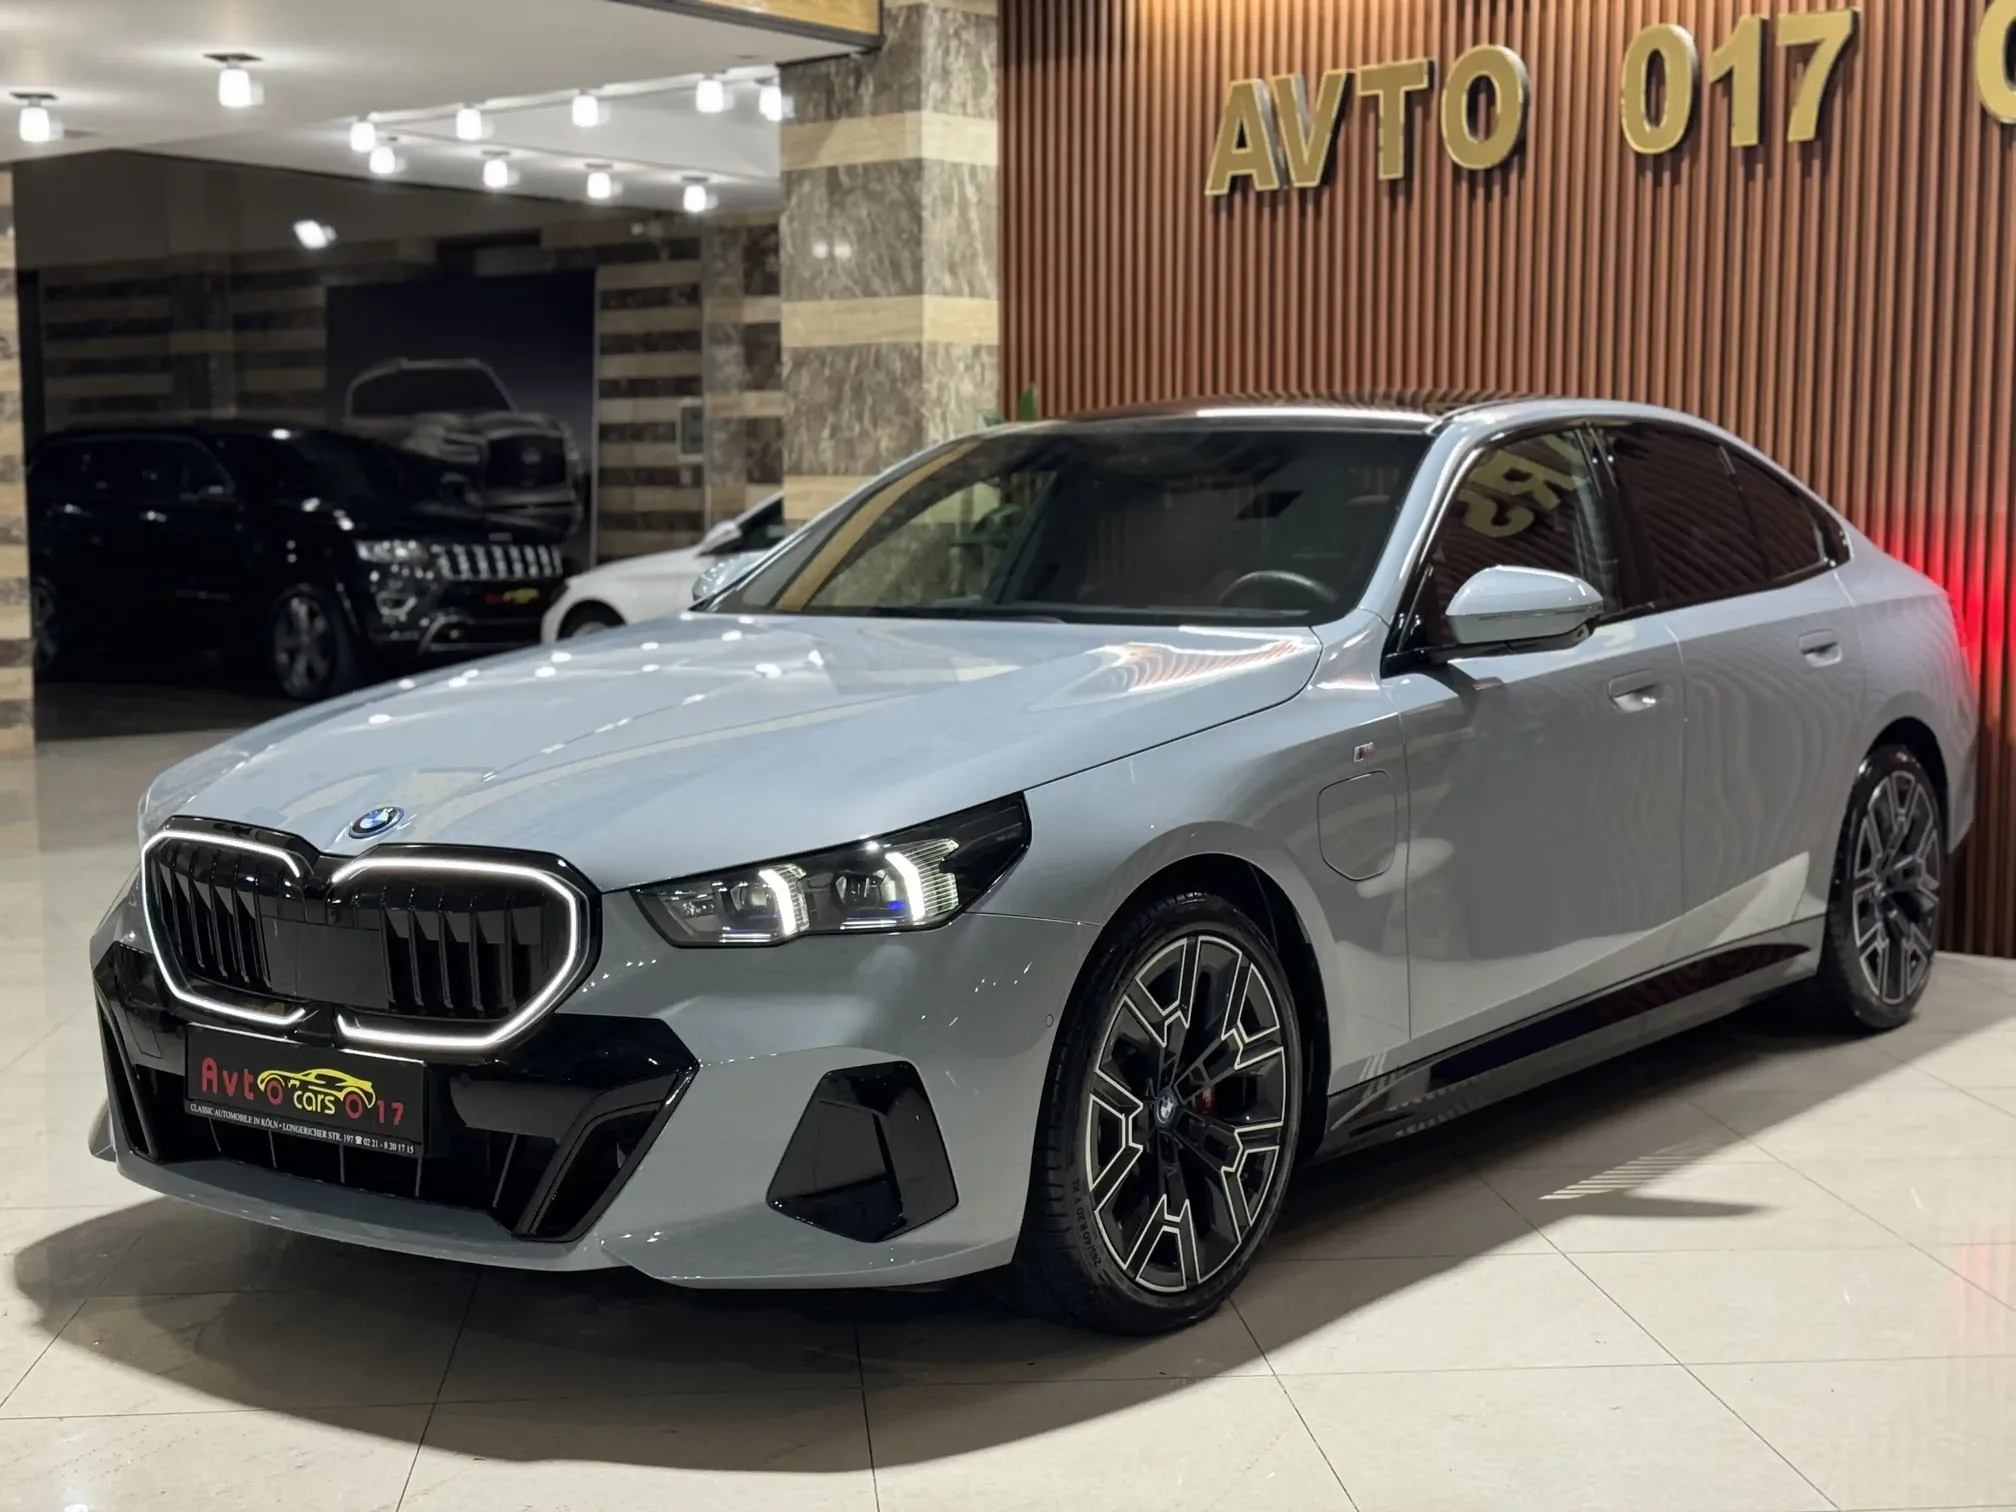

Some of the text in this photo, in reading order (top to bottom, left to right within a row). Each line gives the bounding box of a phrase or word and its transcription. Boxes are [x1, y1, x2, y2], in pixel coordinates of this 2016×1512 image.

[1205, 44, 1531, 195] AVTO
[1621, 6, 1861, 156] 017
[293, 1090, 336, 1115] cars
[190, 1103, 214, 1115] CLASSIC
[214, 1109, 253, 1124] AUTOMOBILE
[253, 1116, 261, 1125] IN
[260, 1118, 278, 1128] KÖLN
[282, 1122, 327, 1138] LONGERICHER
[328, 1131, 342, 1141] STR.
[343, 1133, 354, 1143] 197
